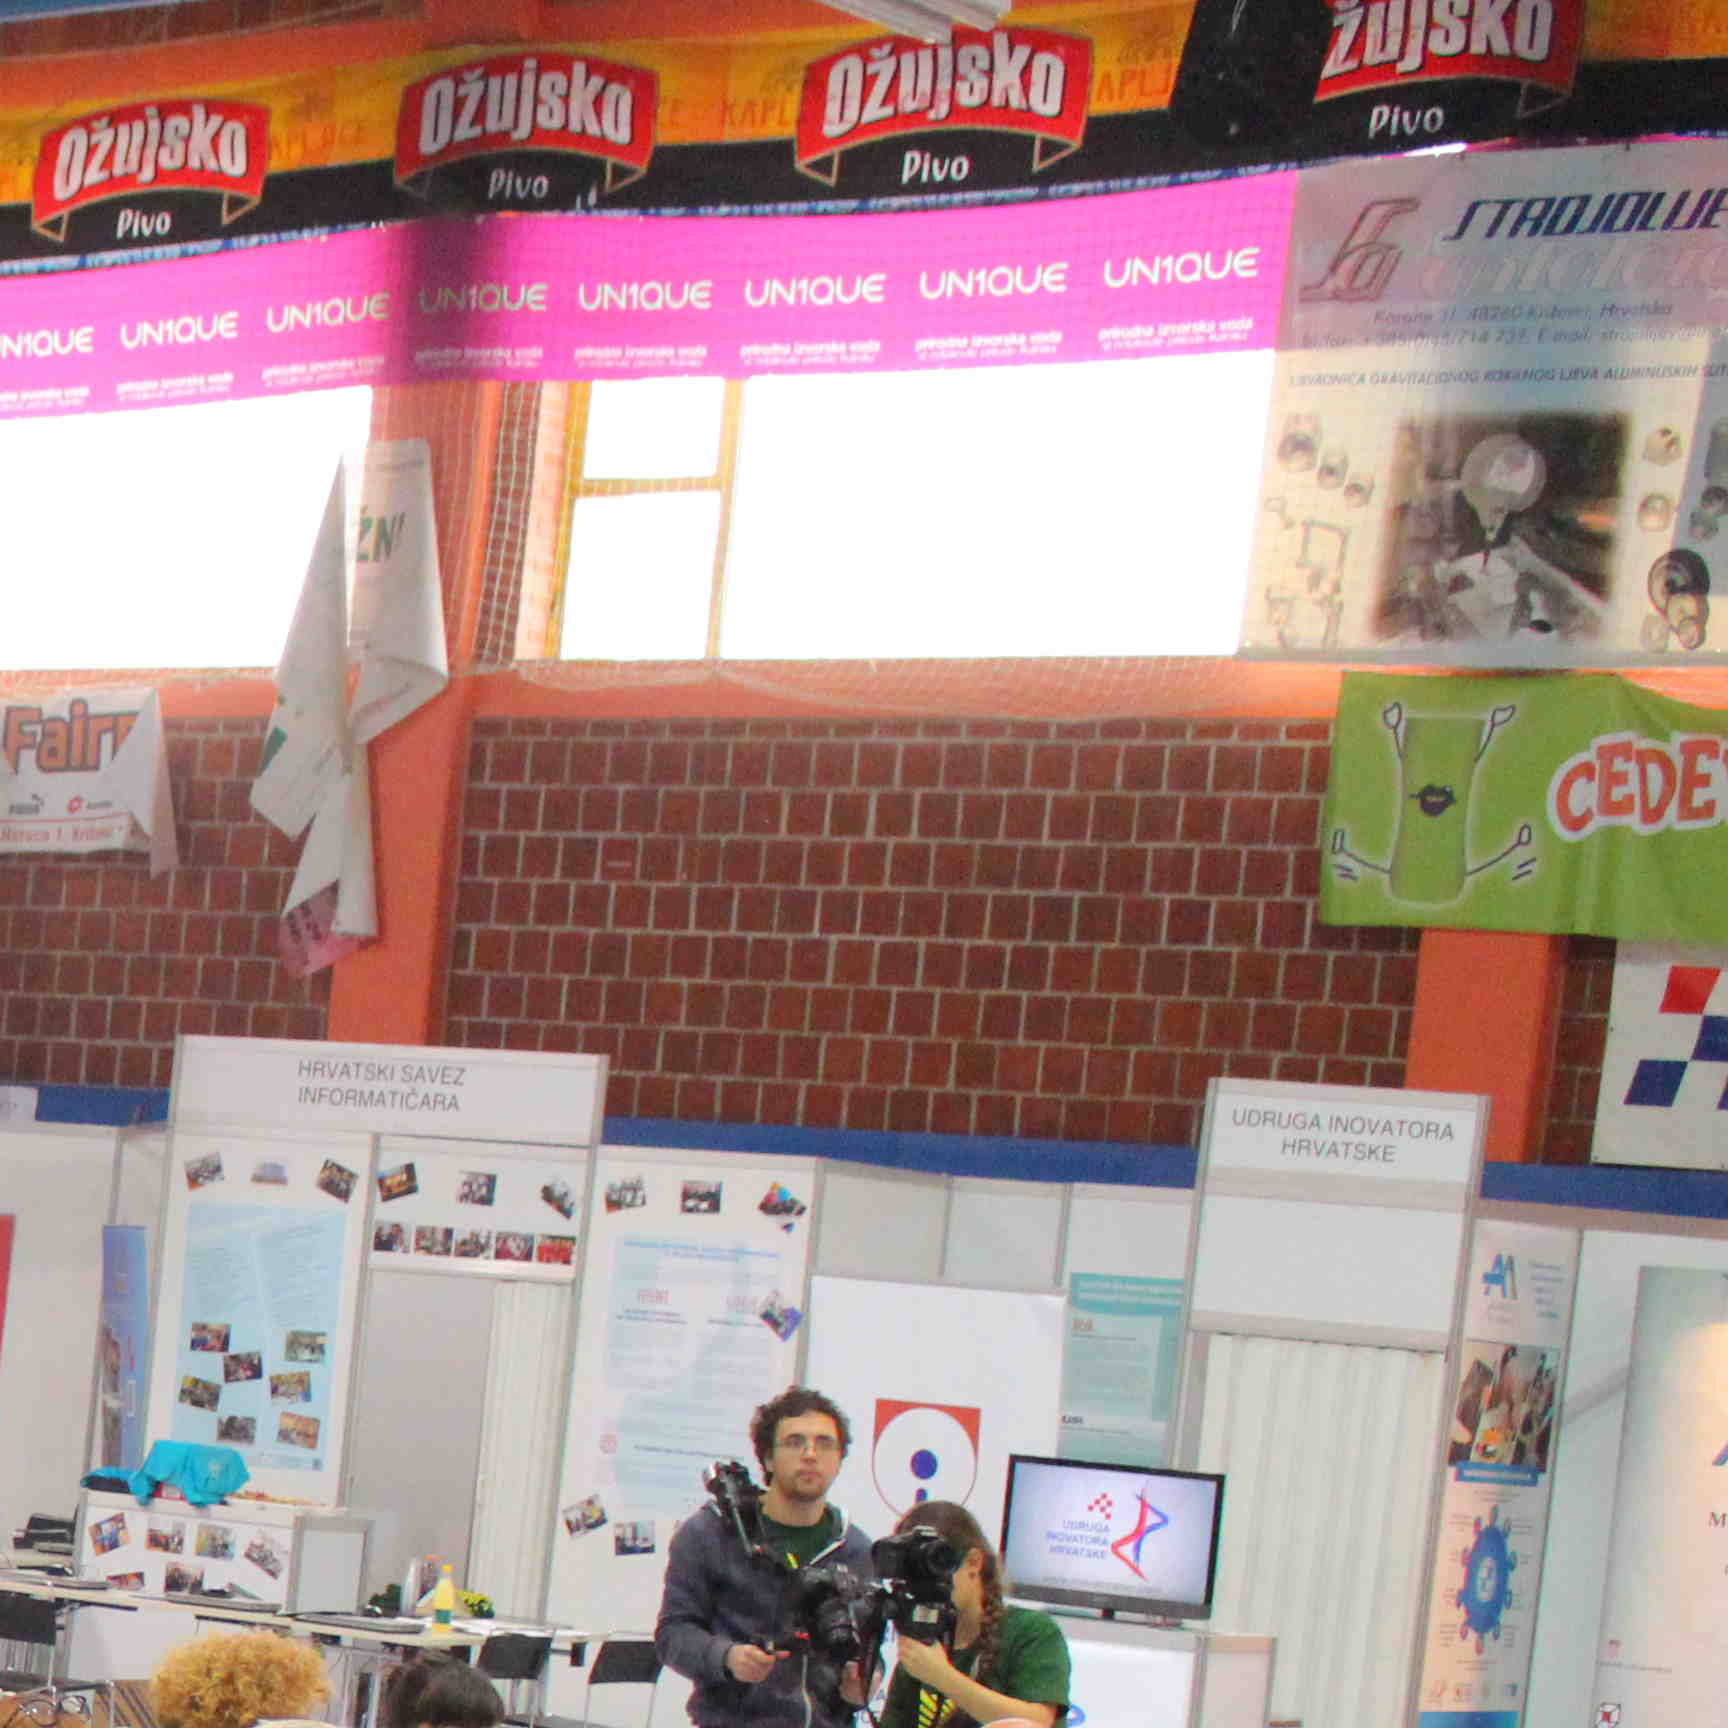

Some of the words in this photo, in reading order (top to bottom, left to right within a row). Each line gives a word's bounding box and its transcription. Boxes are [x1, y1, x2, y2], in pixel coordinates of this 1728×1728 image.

[822, 29, 1064, 139] Ožujsko
[420, 49, 633, 156] Ožujsko
[1368, 105, 1444, 138] Pivo
[55, 103, 248, 200] Ožujsko
[902, 151, 970, 184] Pivo
[488, 167, 550, 200] Pivo
[116, 210, 172, 240] Pivo
[297, 1058, 396, 1083] HRVATSKI
[400, 1064, 467, 1087] SAVEZ
[297, 1086, 461, 1113] INFORMATIČARA
[1232, 1107, 1322, 1134] UDRUGA
[1328, 1114, 1455, 1142] INOVATORA
[1280, 1137, 1396, 1164] HRVATSKE
